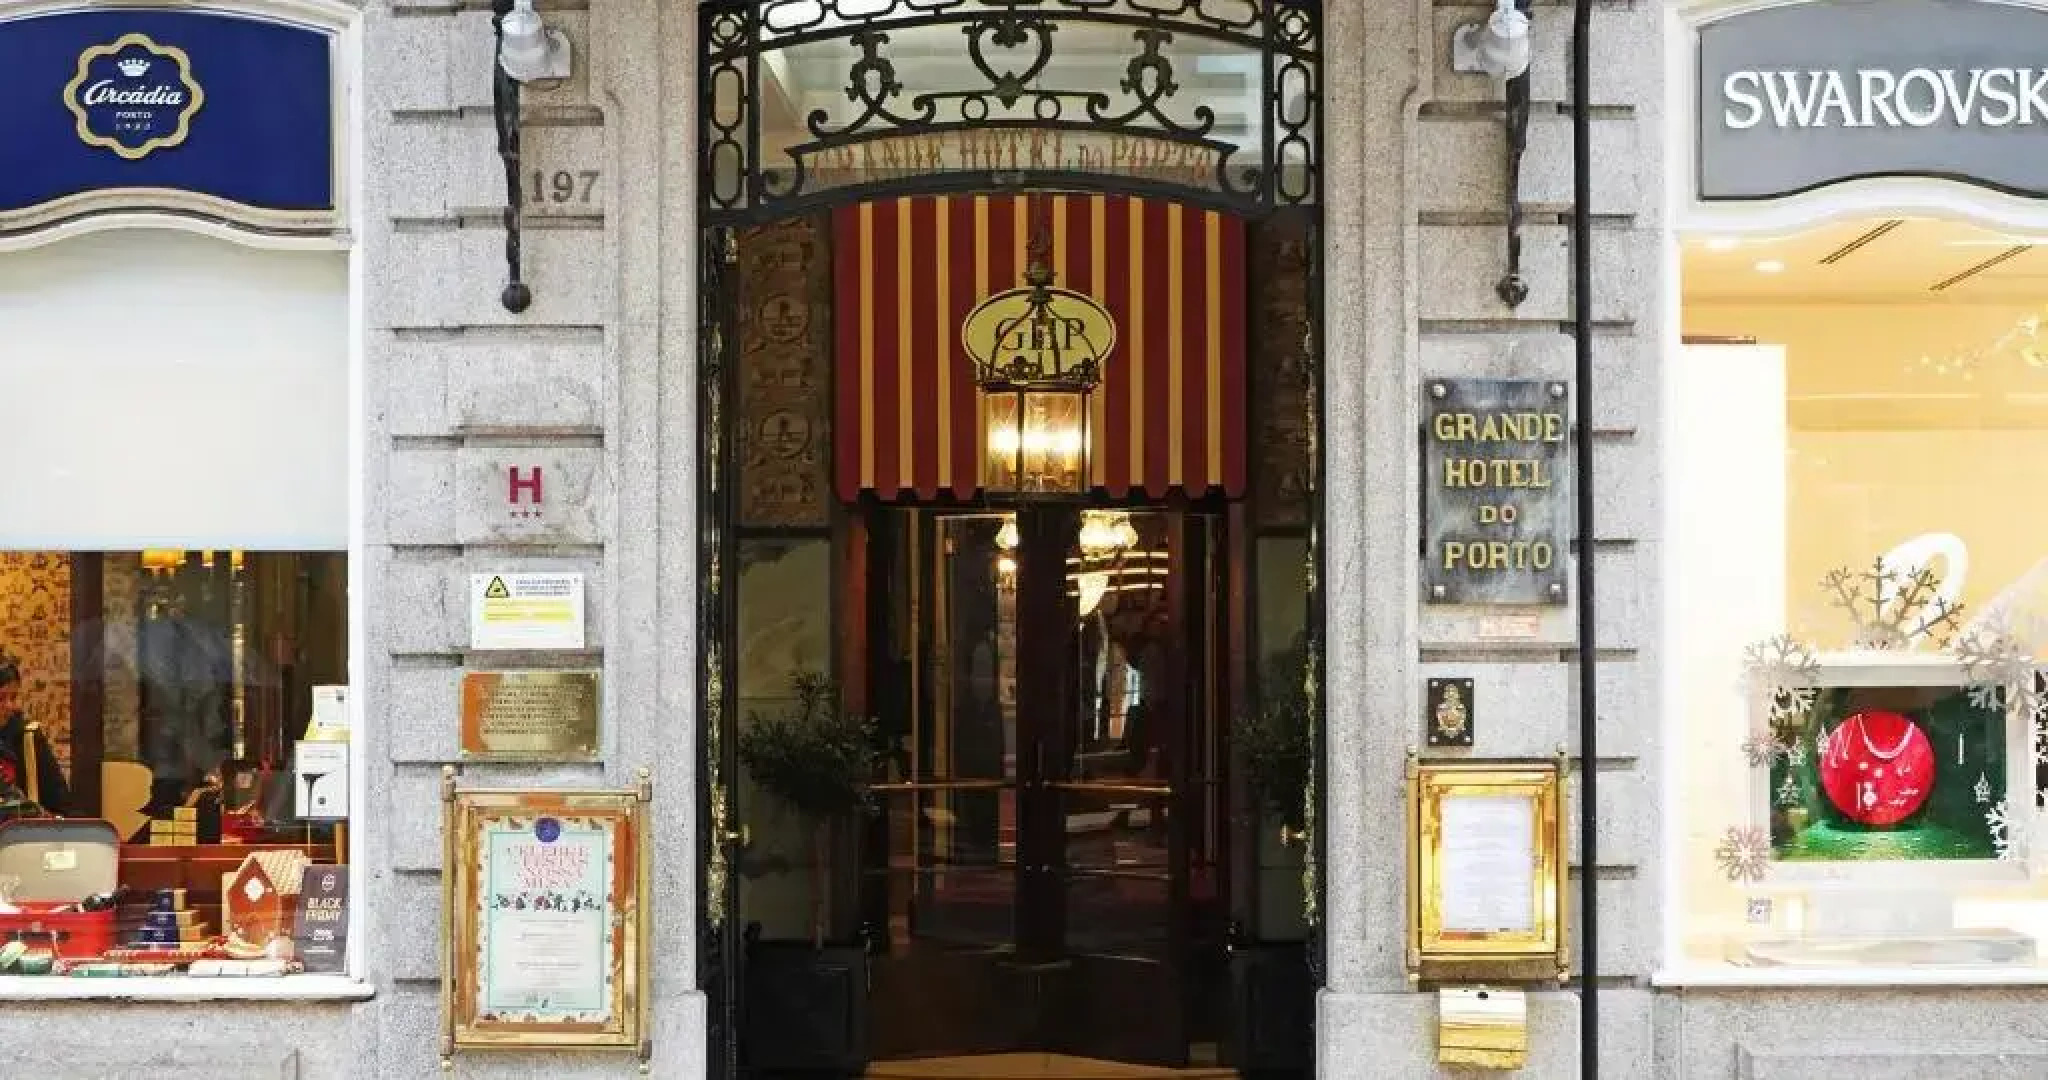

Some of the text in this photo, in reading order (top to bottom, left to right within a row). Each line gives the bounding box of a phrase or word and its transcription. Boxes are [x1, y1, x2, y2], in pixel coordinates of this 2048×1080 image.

[84, 79, 182, 105] Arcádia
[960, 127, 1071, 171] HOTEL
[531, 168, 601, 203] 197
[1434, 412, 1565, 441] GRANDE
[509, 466, 542, 504] H
[1444, 458, 1552, 488] HOTEL
[1479, 504, 1518, 524] DO
[1443, 540, 1553, 570] PORTO
[305, 909, 340, 921] FRIDAY
[307, 897, 342, 909] BLACK
